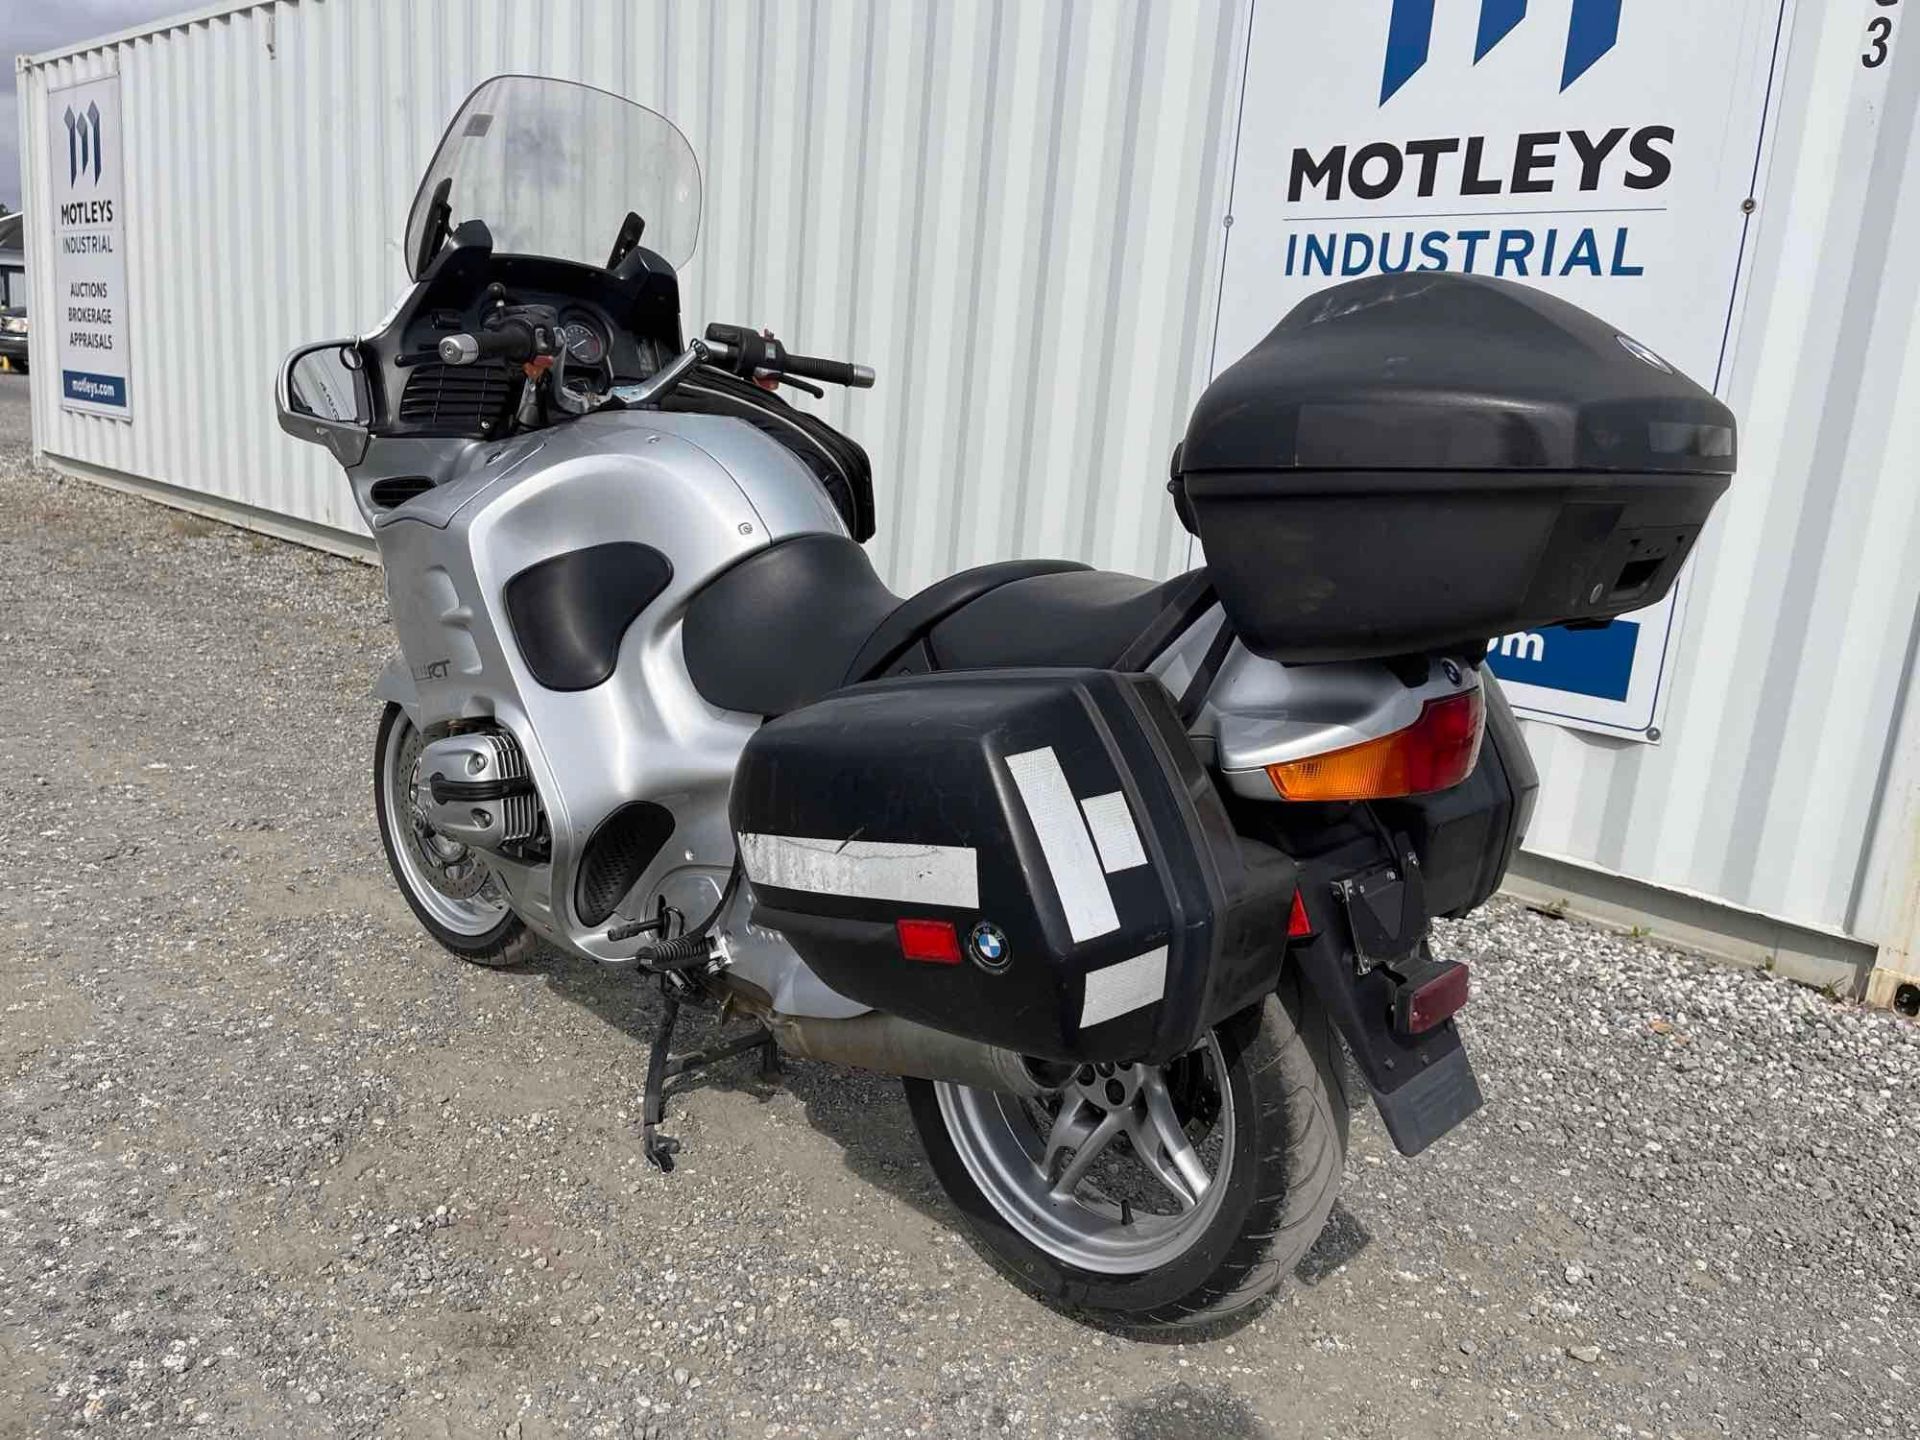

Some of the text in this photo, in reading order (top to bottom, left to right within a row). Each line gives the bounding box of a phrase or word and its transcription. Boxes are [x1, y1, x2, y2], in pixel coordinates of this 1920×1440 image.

[1862, 0, 1898, 68] 3
[1287, 125, 1675, 202] MOTLEYS
[61, 200, 113, 226] MOTLEYS
[63, 235, 113, 254] INDUSTRIAL
[1285, 227, 1644, 277] INDUSTRIAL
[70, 282, 107, 298] AUCTIONS
[68, 306, 112, 325] BROKERAGE
[69, 332, 113, 350] APPRAISALS
[72, 377, 115, 398] motleys.com
